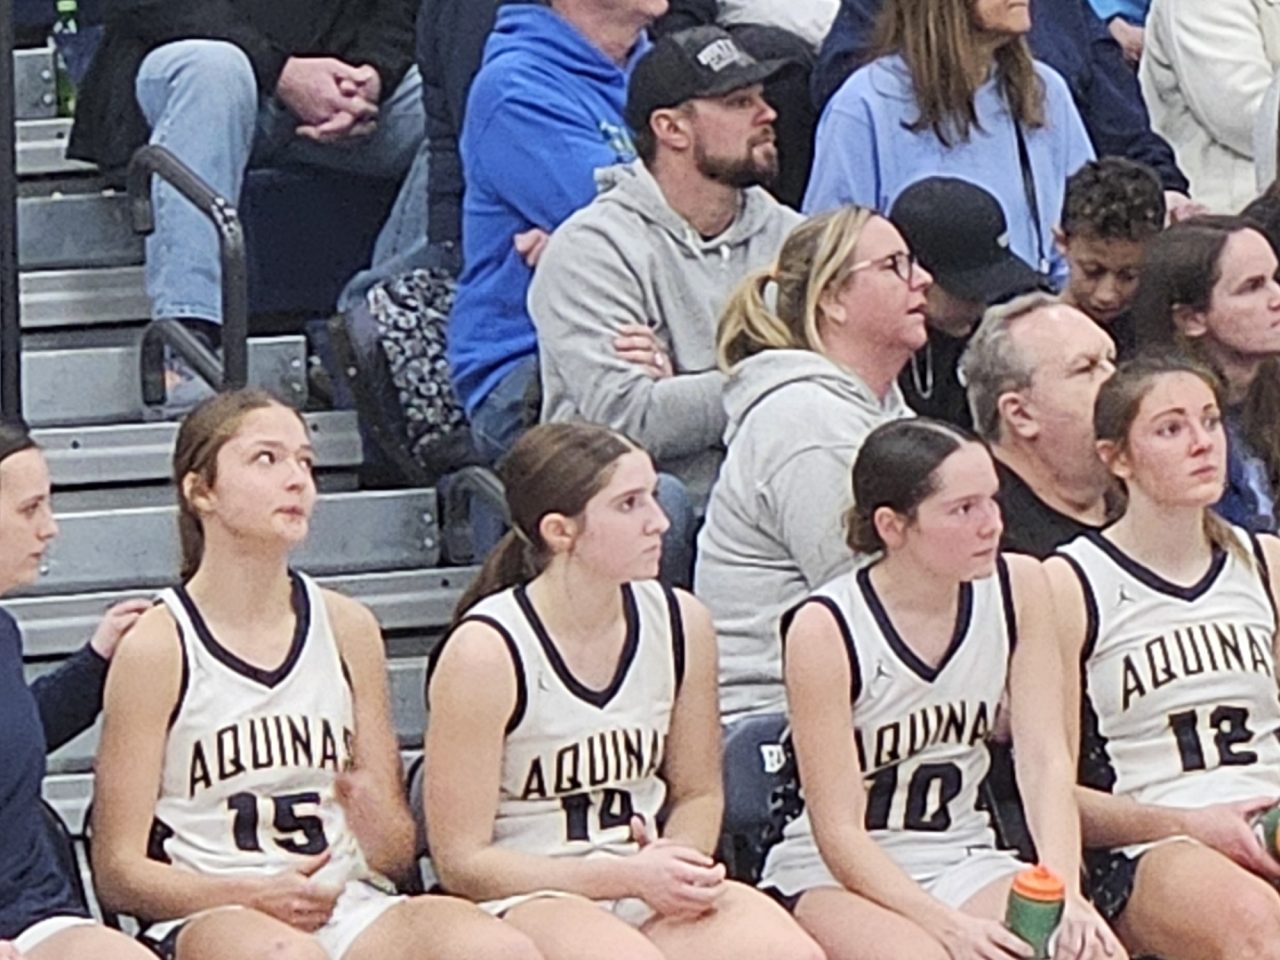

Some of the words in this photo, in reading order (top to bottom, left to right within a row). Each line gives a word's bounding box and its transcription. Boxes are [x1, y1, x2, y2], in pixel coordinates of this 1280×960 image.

[1168, 705, 1258, 772] 12
[227, 791, 329, 856] 15
[560, 787, 646, 842] 14
[863, 761, 963, 832] 10
